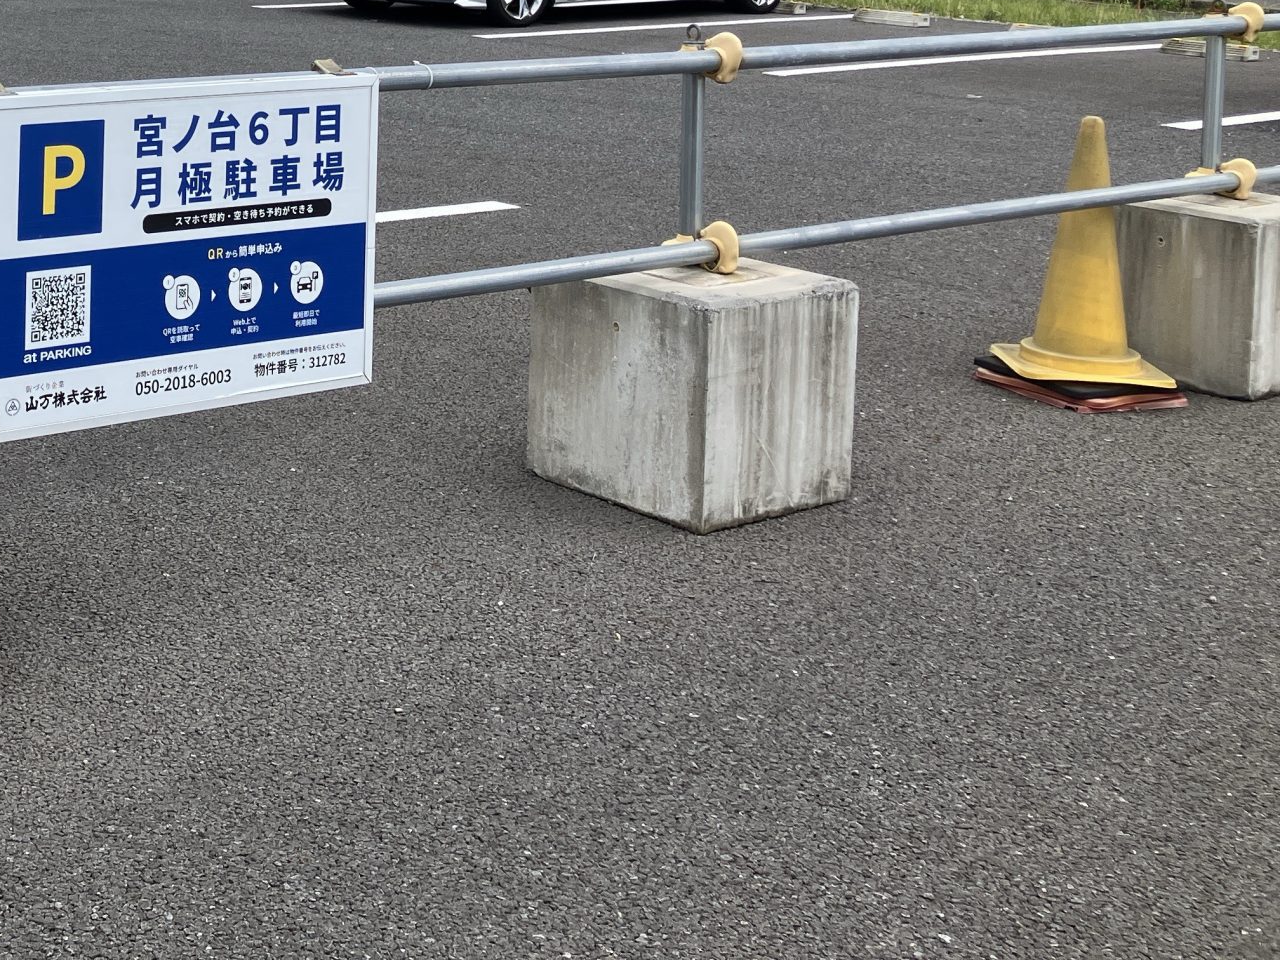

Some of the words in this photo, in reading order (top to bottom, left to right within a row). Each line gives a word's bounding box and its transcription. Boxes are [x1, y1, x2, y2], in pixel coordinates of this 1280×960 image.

[133, 104, 342, 159] 宮ノ台6丁目
[42, 144, 86, 216] P
[130, 151, 345, 209] 月極駐車場
[175, 203, 314, 226] スマホで契約・空き待ち予約ができる
[23, 353, 38, 364] at
[40, 345, 92, 362] PARKING
[135, 363, 199, 378] お問い合わせ専用ダイヤル
[135, 368, 232, 396] 050-2018-6003
[25, 385, 107, 413] 山万株式会社
